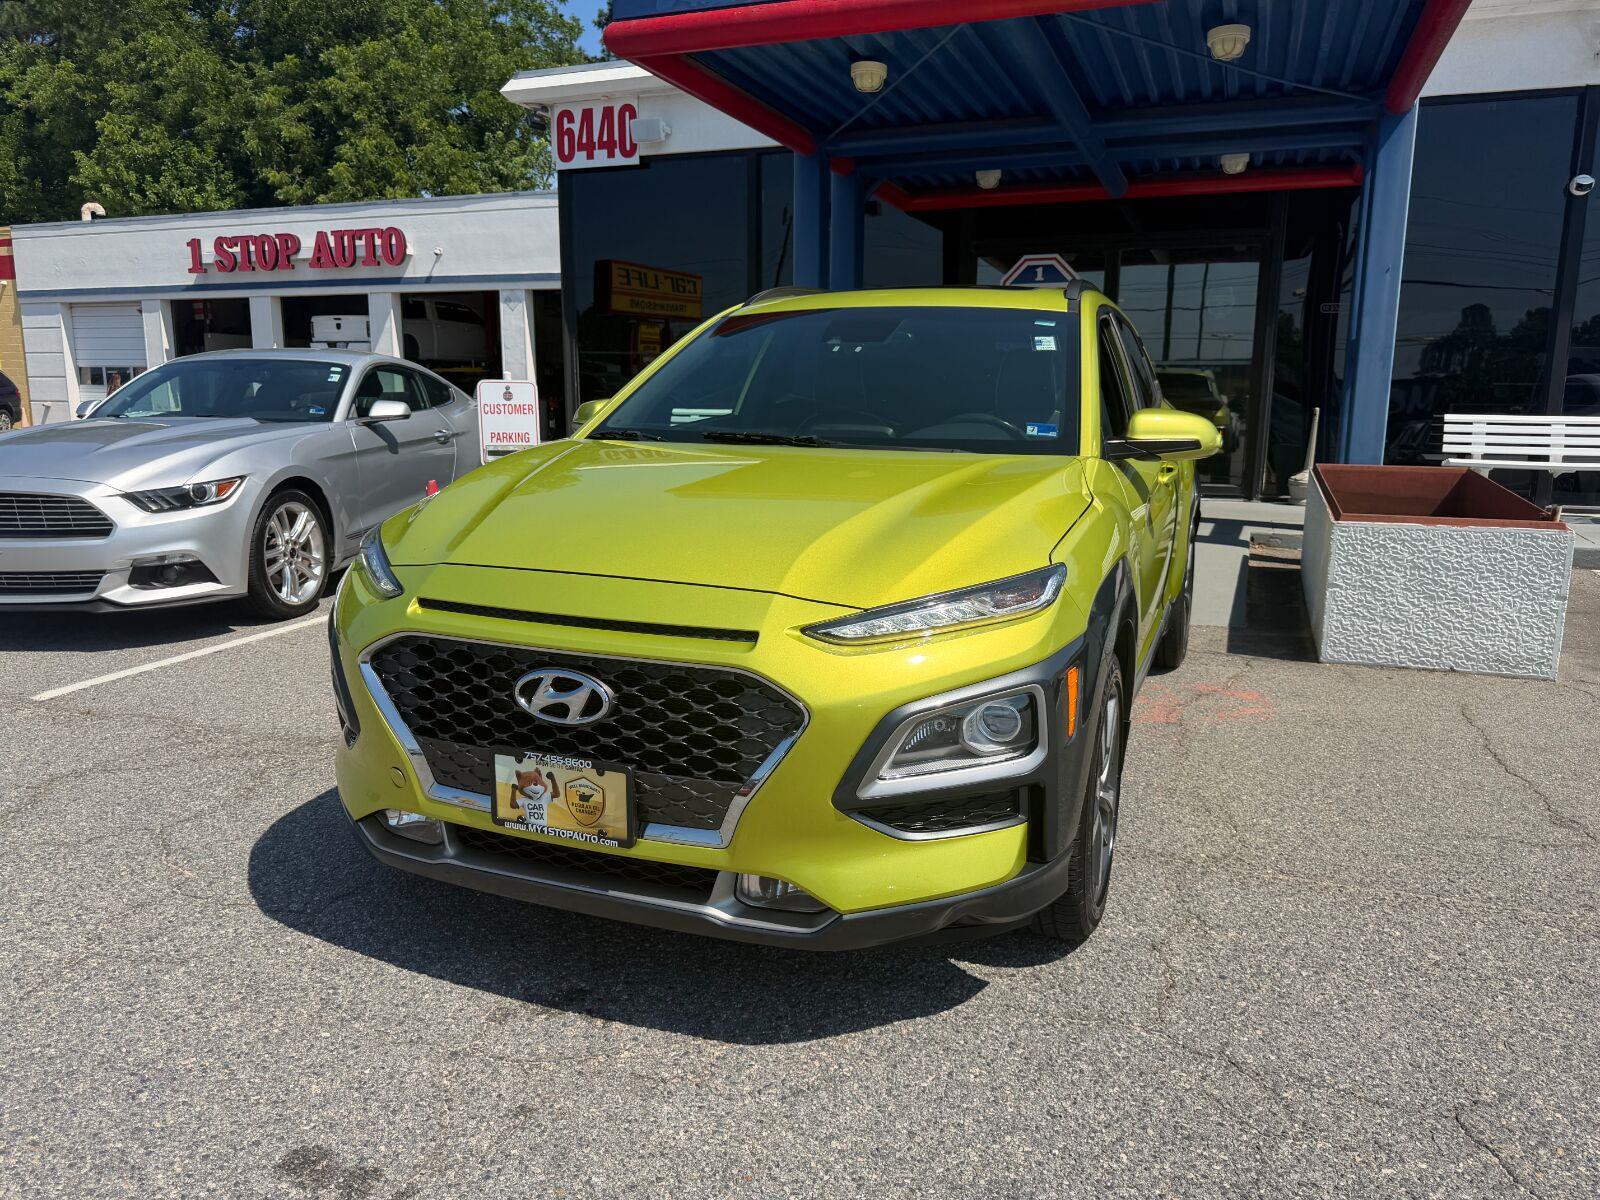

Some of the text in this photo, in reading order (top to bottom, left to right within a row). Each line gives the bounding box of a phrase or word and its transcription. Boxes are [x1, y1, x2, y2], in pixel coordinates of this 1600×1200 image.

[557, 103, 638, 163] 6440
[187, 227, 408, 274] 1 STOP AUTO
[1035, 266, 1045, 281] 1
[483, 403, 534, 415] CUSTOMER
[490, 432, 531, 443] PARKING
[524, 752, 592, 769] 757-455-8600
[527, 803, 544, 811] CAR
[528, 811, 545, 820] FOX
[504, 821, 618, 847] www.MY1STOPAUTO.com
